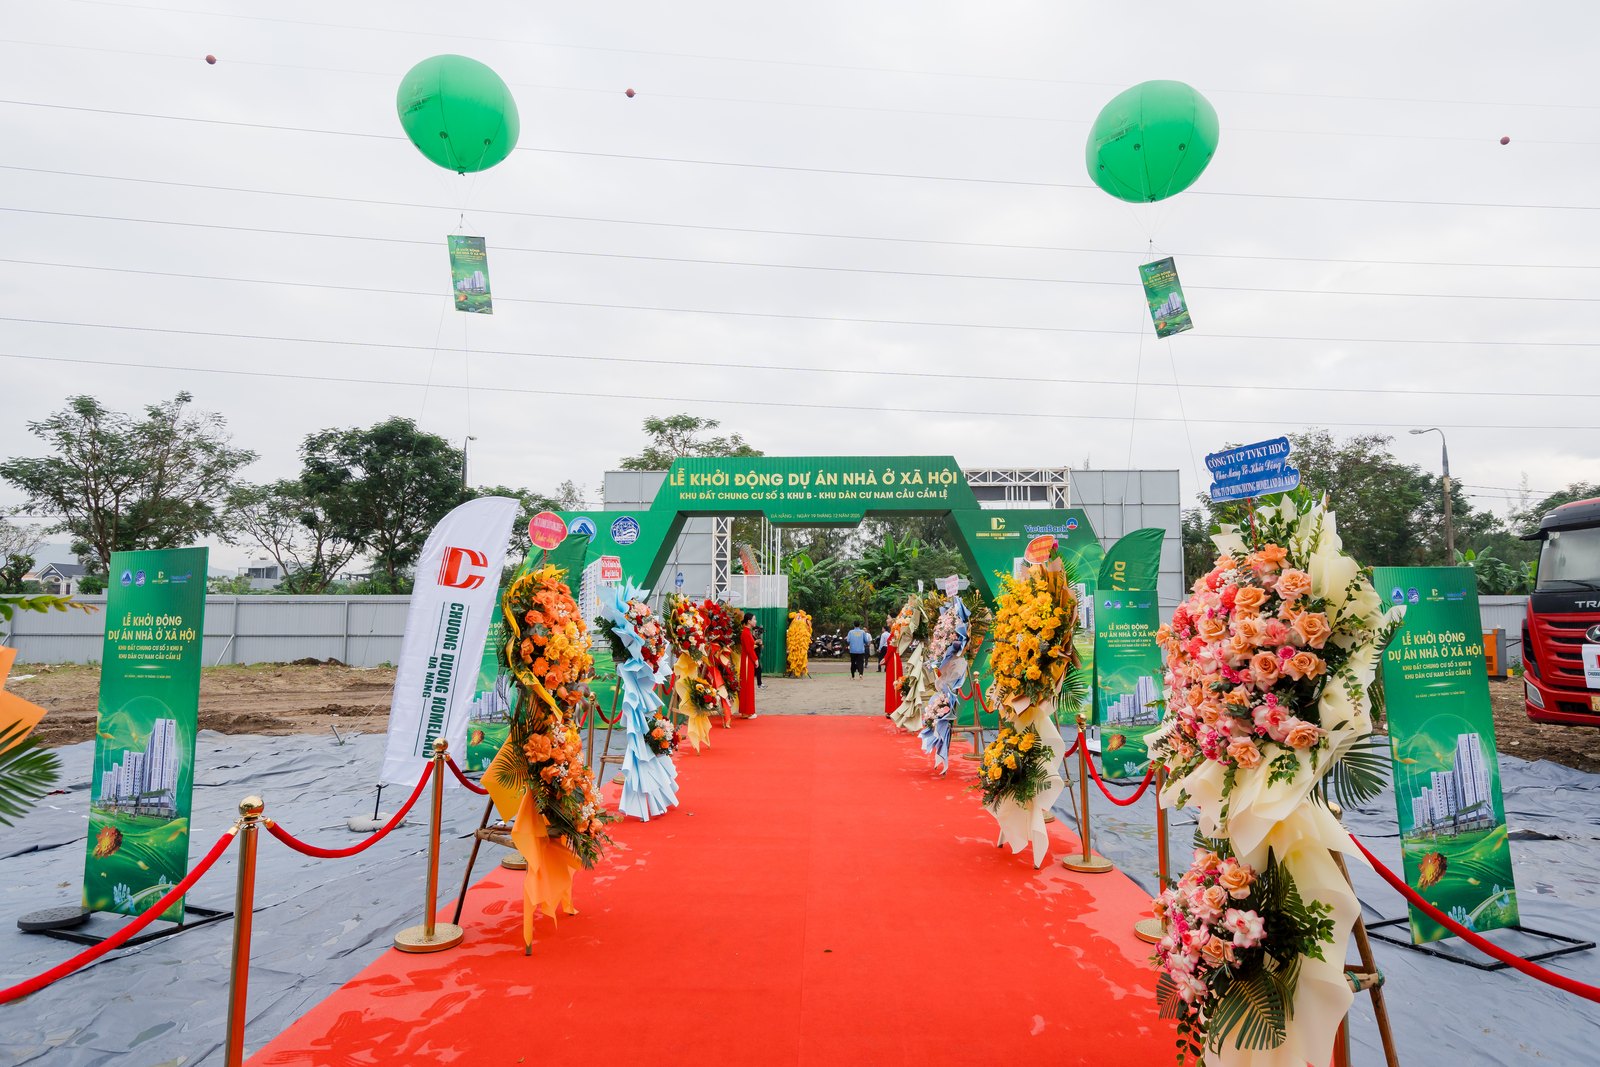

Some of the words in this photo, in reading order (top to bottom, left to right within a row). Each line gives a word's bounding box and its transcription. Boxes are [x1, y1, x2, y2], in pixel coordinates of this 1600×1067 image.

[1208, 456, 1226, 468] CÔNG
[1226, 454, 1236, 464] TY
[1236, 452, 1245, 462] CP
[1244, 446, 1268, 460] TVKT
[1269, 442, 1287, 455] HDC
[670, 468, 685, 486] LỄ
[690, 469, 730, 486] KHỞI
[734, 470, 784, 490] ĐỘNG
[788, 471, 811, 489] DỰ
[815, 469, 838, 486] ÁN
[843, 469, 878, 485] NHÀ
[882, 468, 896, 485] Ở
[900, 468, 924, 484] XÃ
[928, 468, 958, 488] HỘI
[700, 490, 716, 500] ĐẤT
[751, 492, 764, 500] CƯ
[766, 490, 778, 500] SỐ
[839, 490, 857, 499] DÂN
[860, 491, 873, 499] CƯ
[896, 488, 914, 498] CẦU
[939, 488, 948, 500] LỆ
[123, 612, 131, 626] LỄ
[133, 612, 153, 626] KHỞI
[156, 614, 182, 629] ĐỘNG
[443, 602, 464, 650] CHUONG
[108, 629, 120, 643] DỰ
[121, 628, 133, 640] ÁN
[136, 628, 153, 640] NHÀ
[156, 627, 163, 640] Ở
[165, 628, 177, 640] XÃ
[180, 627, 196, 643] HỘI
[1148, 630, 1157, 639] HỘ
[1402, 631, 1412, 645] LỄ
[1414, 632, 1436, 644] KHỞI
[1439, 630, 1466, 645] ĐỘNG
[428, 656, 438, 669] DA
[1388, 649, 1402, 664] DỰ
[1404, 648, 1417, 660] ÁN
[1420, 646, 1439, 659] NHÀ
[1441, 644, 1449, 657] Ở
[1451, 645, 1464, 657] XÃ
[1466, 643, 1482, 658] HỘI
[434, 653, 455, 694] DUONG
[422, 672, 435, 698] NANG
